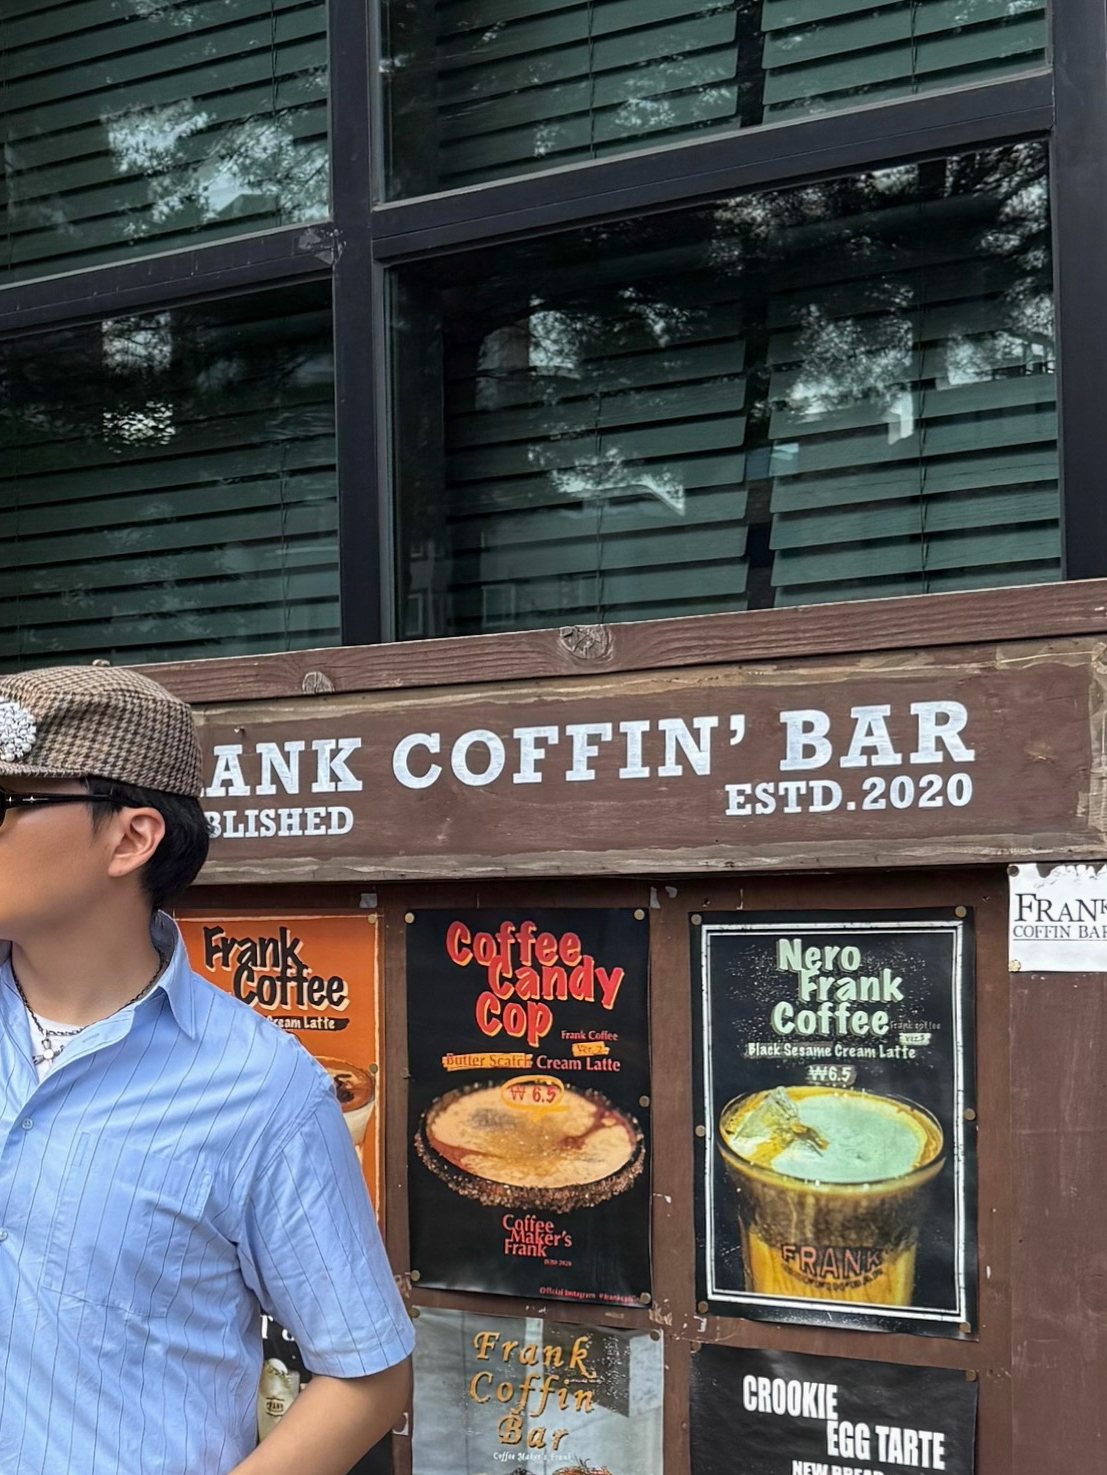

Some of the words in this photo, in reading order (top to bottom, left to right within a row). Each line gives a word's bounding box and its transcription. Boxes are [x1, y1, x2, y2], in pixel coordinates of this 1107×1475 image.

[200, 737, 363, 798] ANK
[392, 714, 746, 790] COFFIN'
[780, 700, 976, 772] BAR
[725, 772, 974, 818] ESTD.2020
[203, 925, 312, 973] Frank
[1013, 925, 1071, 938] COFFIN
[446, 920, 582, 979] Coffee
[776, 938, 861, 972] Nero
[233, 961, 350, 1012] Coffee
[488, 954, 625, 1010] Candy
[798, 968, 905, 1002] Frank
[304, 1016, 335, 1029] Latte
[476, 991, 553, 1048] Cop
[561, 1030, 586, 1040] Frank
[588, 1030, 619, 1041] Coffee
[771, 1000, 889, 1036] Coffee
[446, 1053, 485, 1067] Butter
[536, 1055, 581, 1070] Cream
[586, 1057, 621, 1071] Latte
[748, 1042, 781, 1057] Black
[783, 1043, 832, 1058] Sesame
[835, 1045, 876, 1058] Cream
[879, 1045, 916, 1059] Latte
[532, 1085, 558, 1103] 6.5
[503, 1214, 554, 1232] Coffee
[511, 1228, 572, 1247] Maker's
[504, 1238, 547, 1257] Frank
[781, 1244, 883, 1279] FRANK
[473, 1331, 597, 1379] Frank
[469, 1371, 595, 1417] Coffin
[743, 1374, 838, 1421] CROOKIE
[497, 1413, 569, 1451] Bar
[826, 1420, 871, 1461] EGG
[875, 1425, 946, 1471] TARTE
[493, 1451, 515, 1462] Coffee
